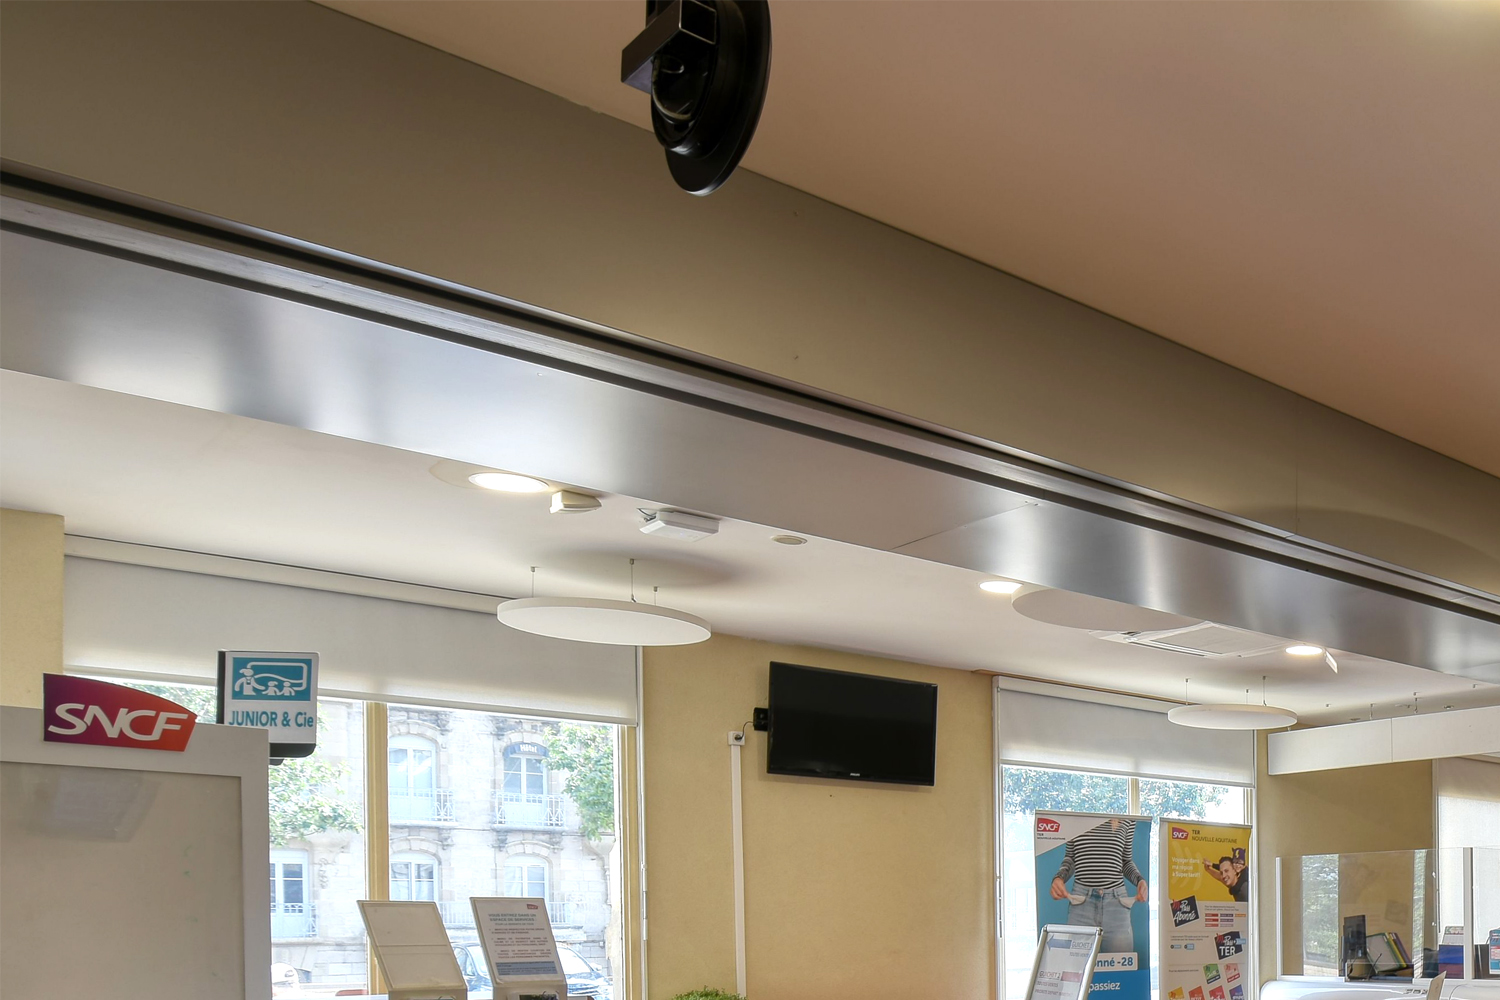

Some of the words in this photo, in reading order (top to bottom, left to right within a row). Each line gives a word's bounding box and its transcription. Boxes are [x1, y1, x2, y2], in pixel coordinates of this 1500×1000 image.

[47, 702, 188, 741] SNCF
[228, 710, 278, 727] JUNIOR
[281, 711, 291, 727] &
[294, 710, 314, 727] Cie
[1037, 823, 1058, 831] SNCF
[1071, 941, 1089, 949] GUICHET
[1219, 946, 1236, 956] TER
[1088, 980, 1120, 993] passiez
